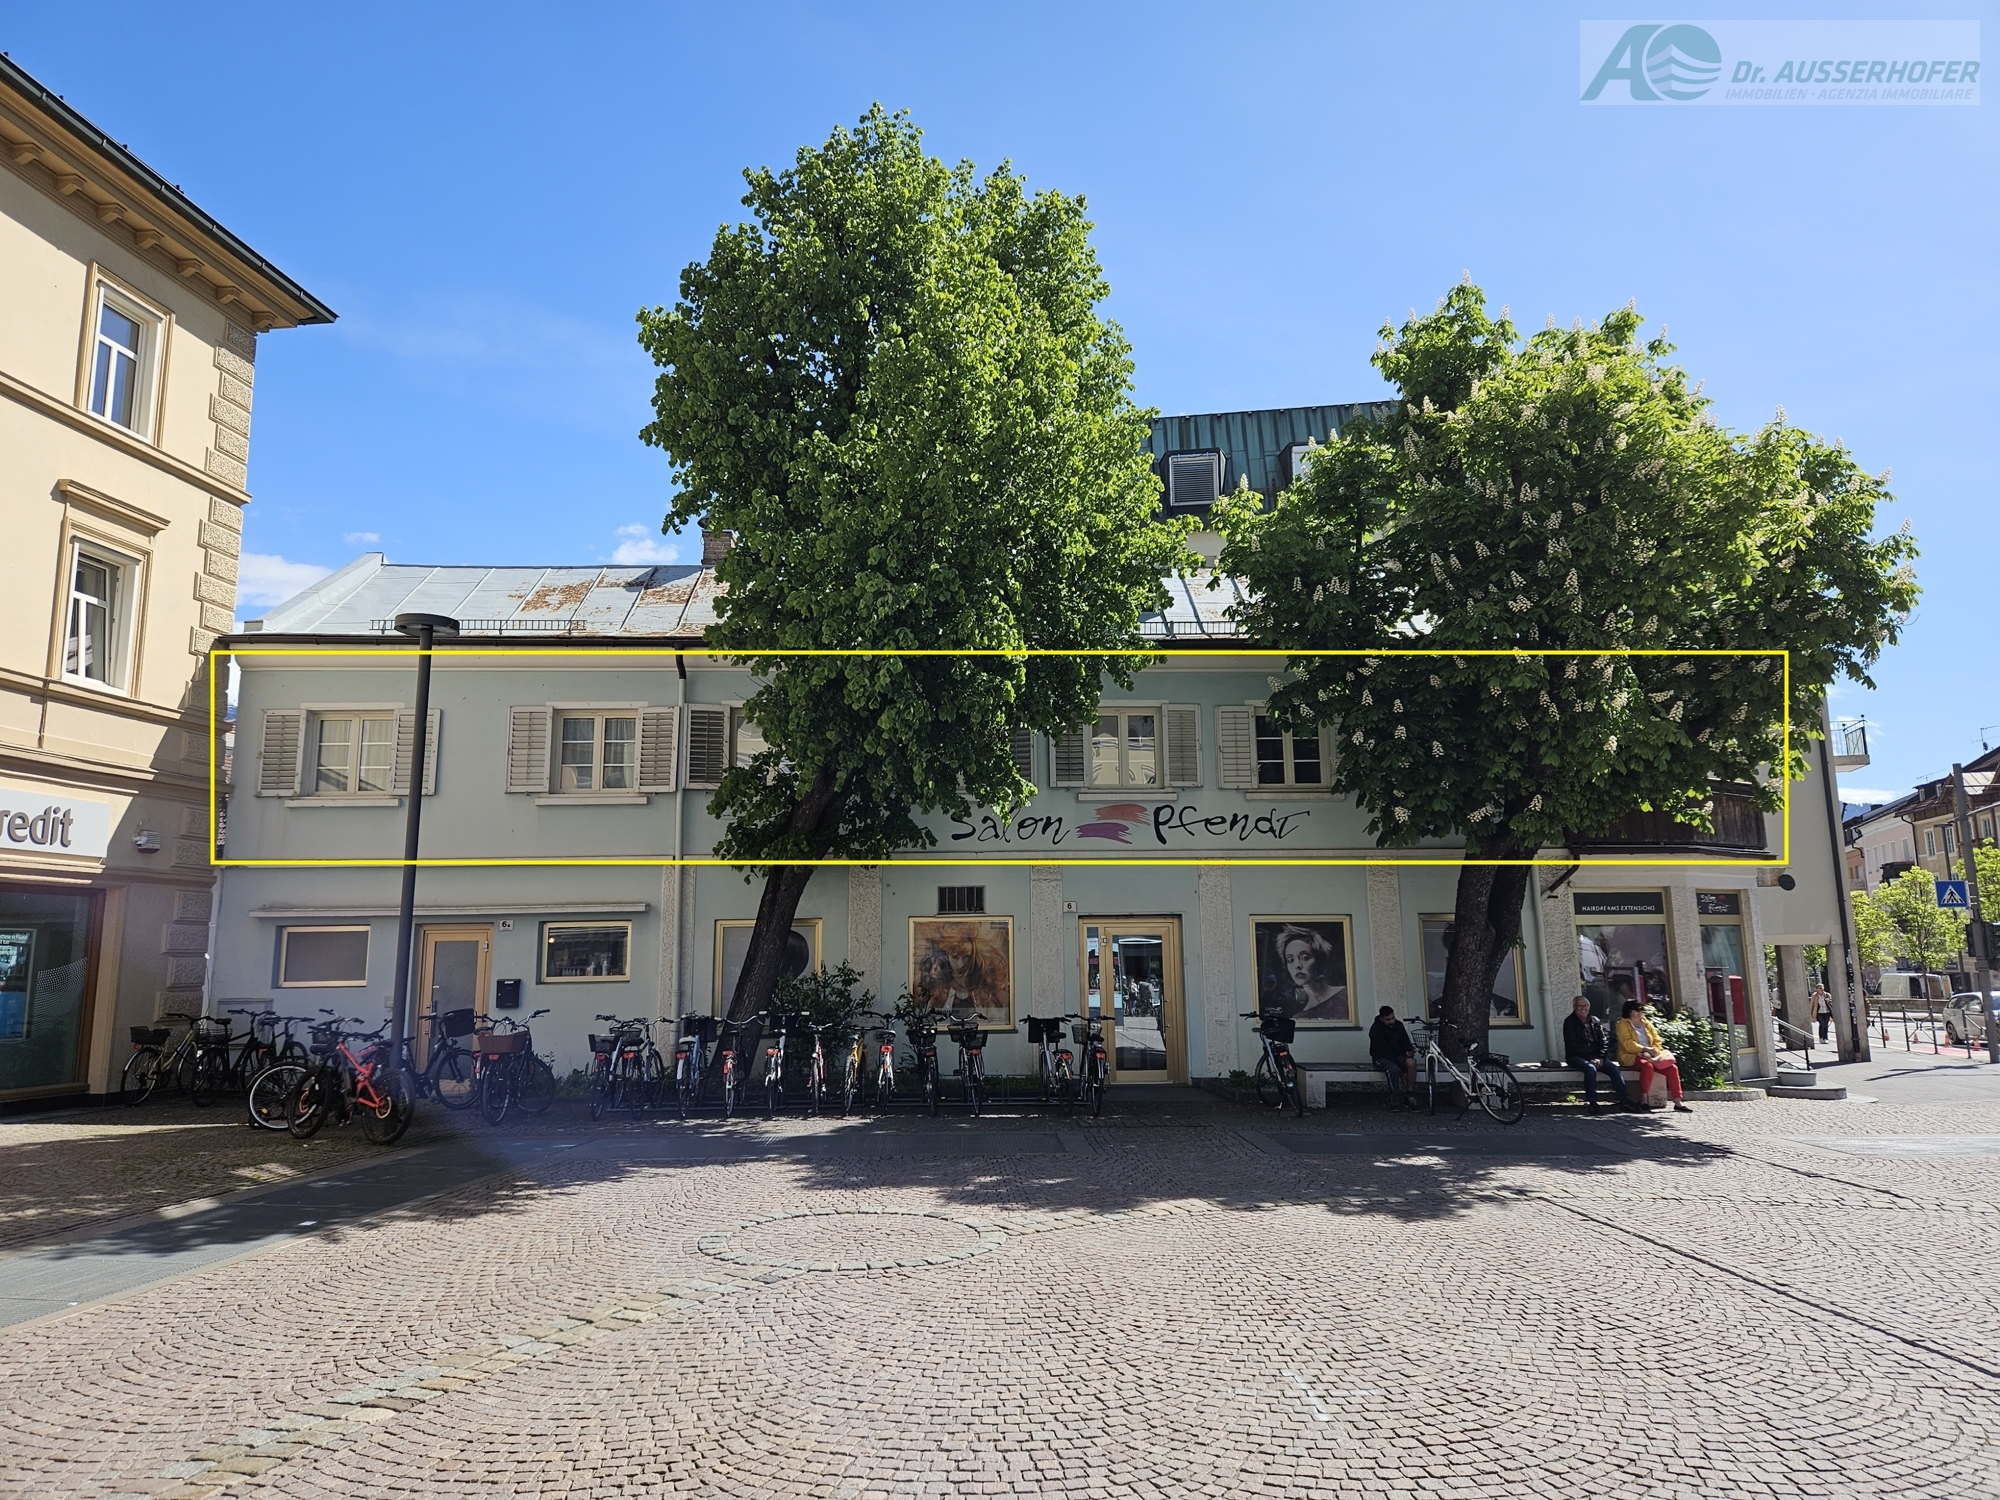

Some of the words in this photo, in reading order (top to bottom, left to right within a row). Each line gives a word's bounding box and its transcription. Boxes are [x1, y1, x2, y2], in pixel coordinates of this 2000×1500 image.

[950, 800, 1070, 845] Salon
[1152, 803, 1310, 845] Pfendt
[501, 920, 511, 928] 6a
